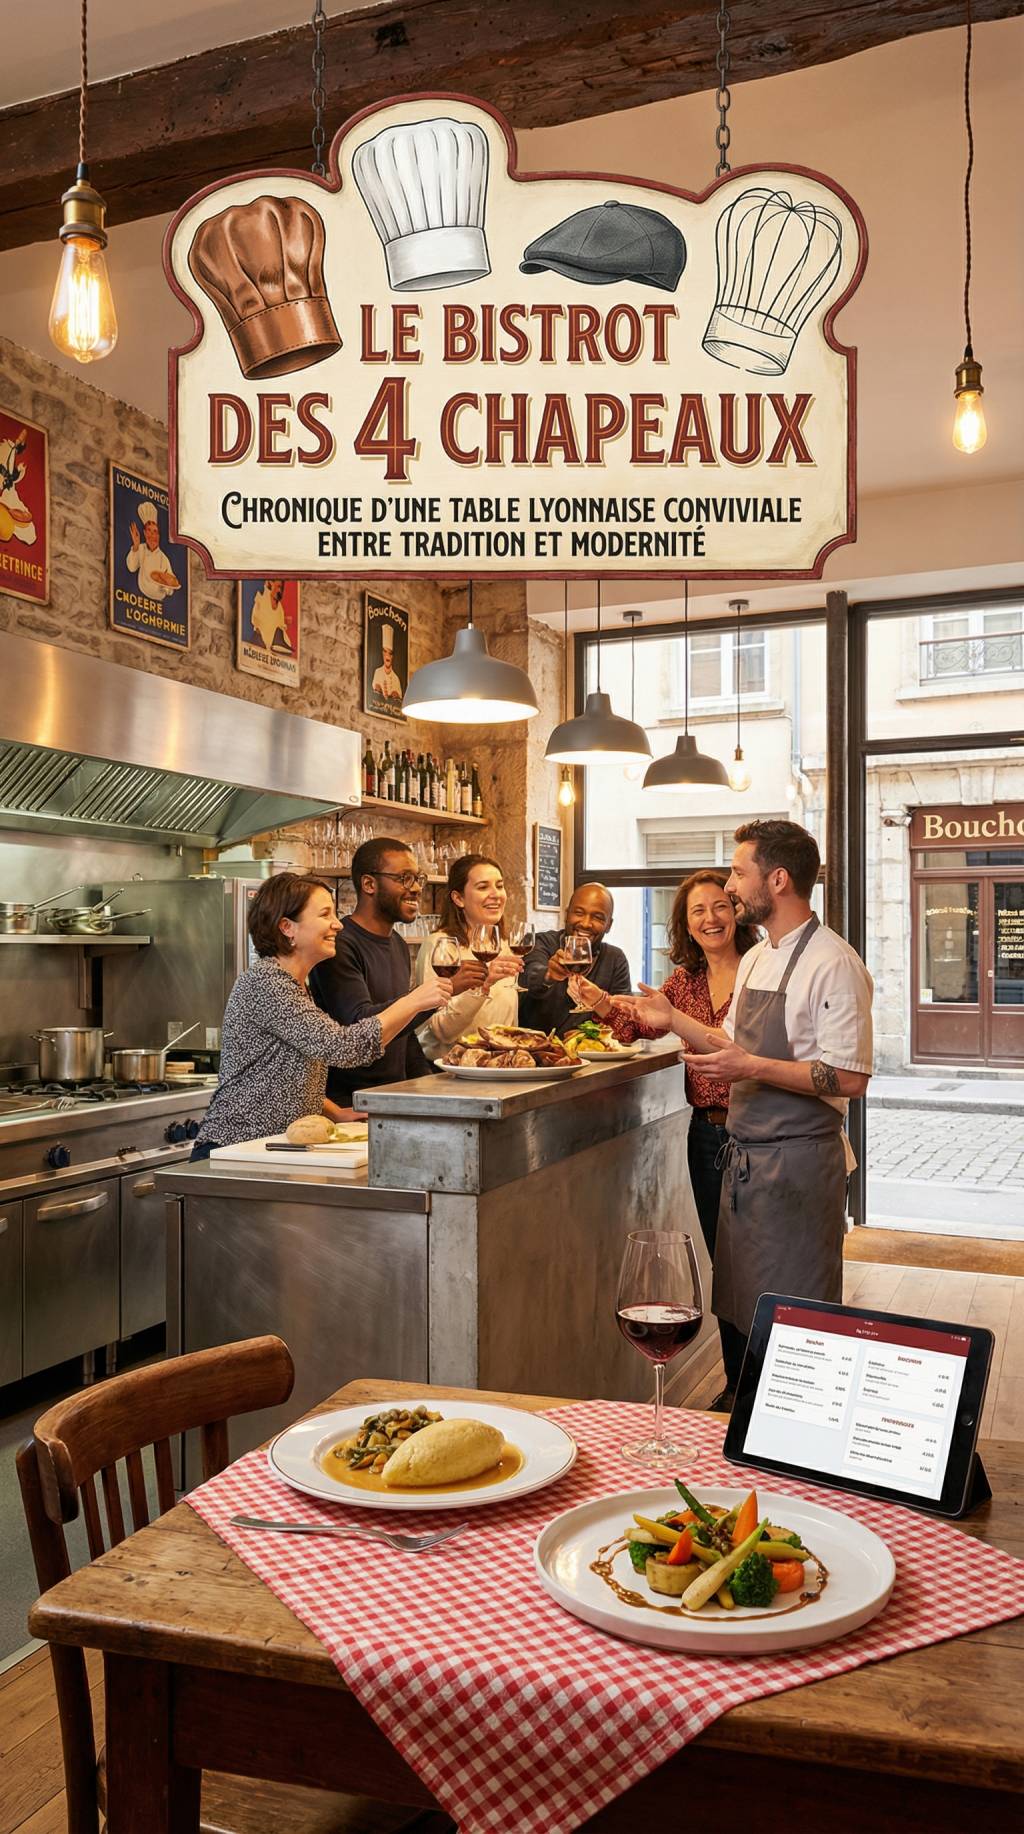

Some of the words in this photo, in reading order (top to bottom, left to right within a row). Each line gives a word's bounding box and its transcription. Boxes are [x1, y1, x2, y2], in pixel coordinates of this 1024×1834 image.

[360, 304, 423, 364] LE
[443, 304, 679, 364] BISTROT
[208, 392, 336, 468] DES
[353, 377, 420, 484] 4
[440, 392, 817, 468] CHAPEAUX
[221, 491, 362, 529] CHRONIQUE
[371, 497, 441, 522] D'UNE
[449, 497, 520, 522] TABLE
[529, 497, 655, 522] LYONNAISE
[664, 497, 802, 522] CONVIVIALE
[318, 531, 391, 556] ENTRE
[400, 531, 525, 556] TRADITION
[535, 531, 562, 556] ET
[572, 525, 706, 556] MODERNITÉ
